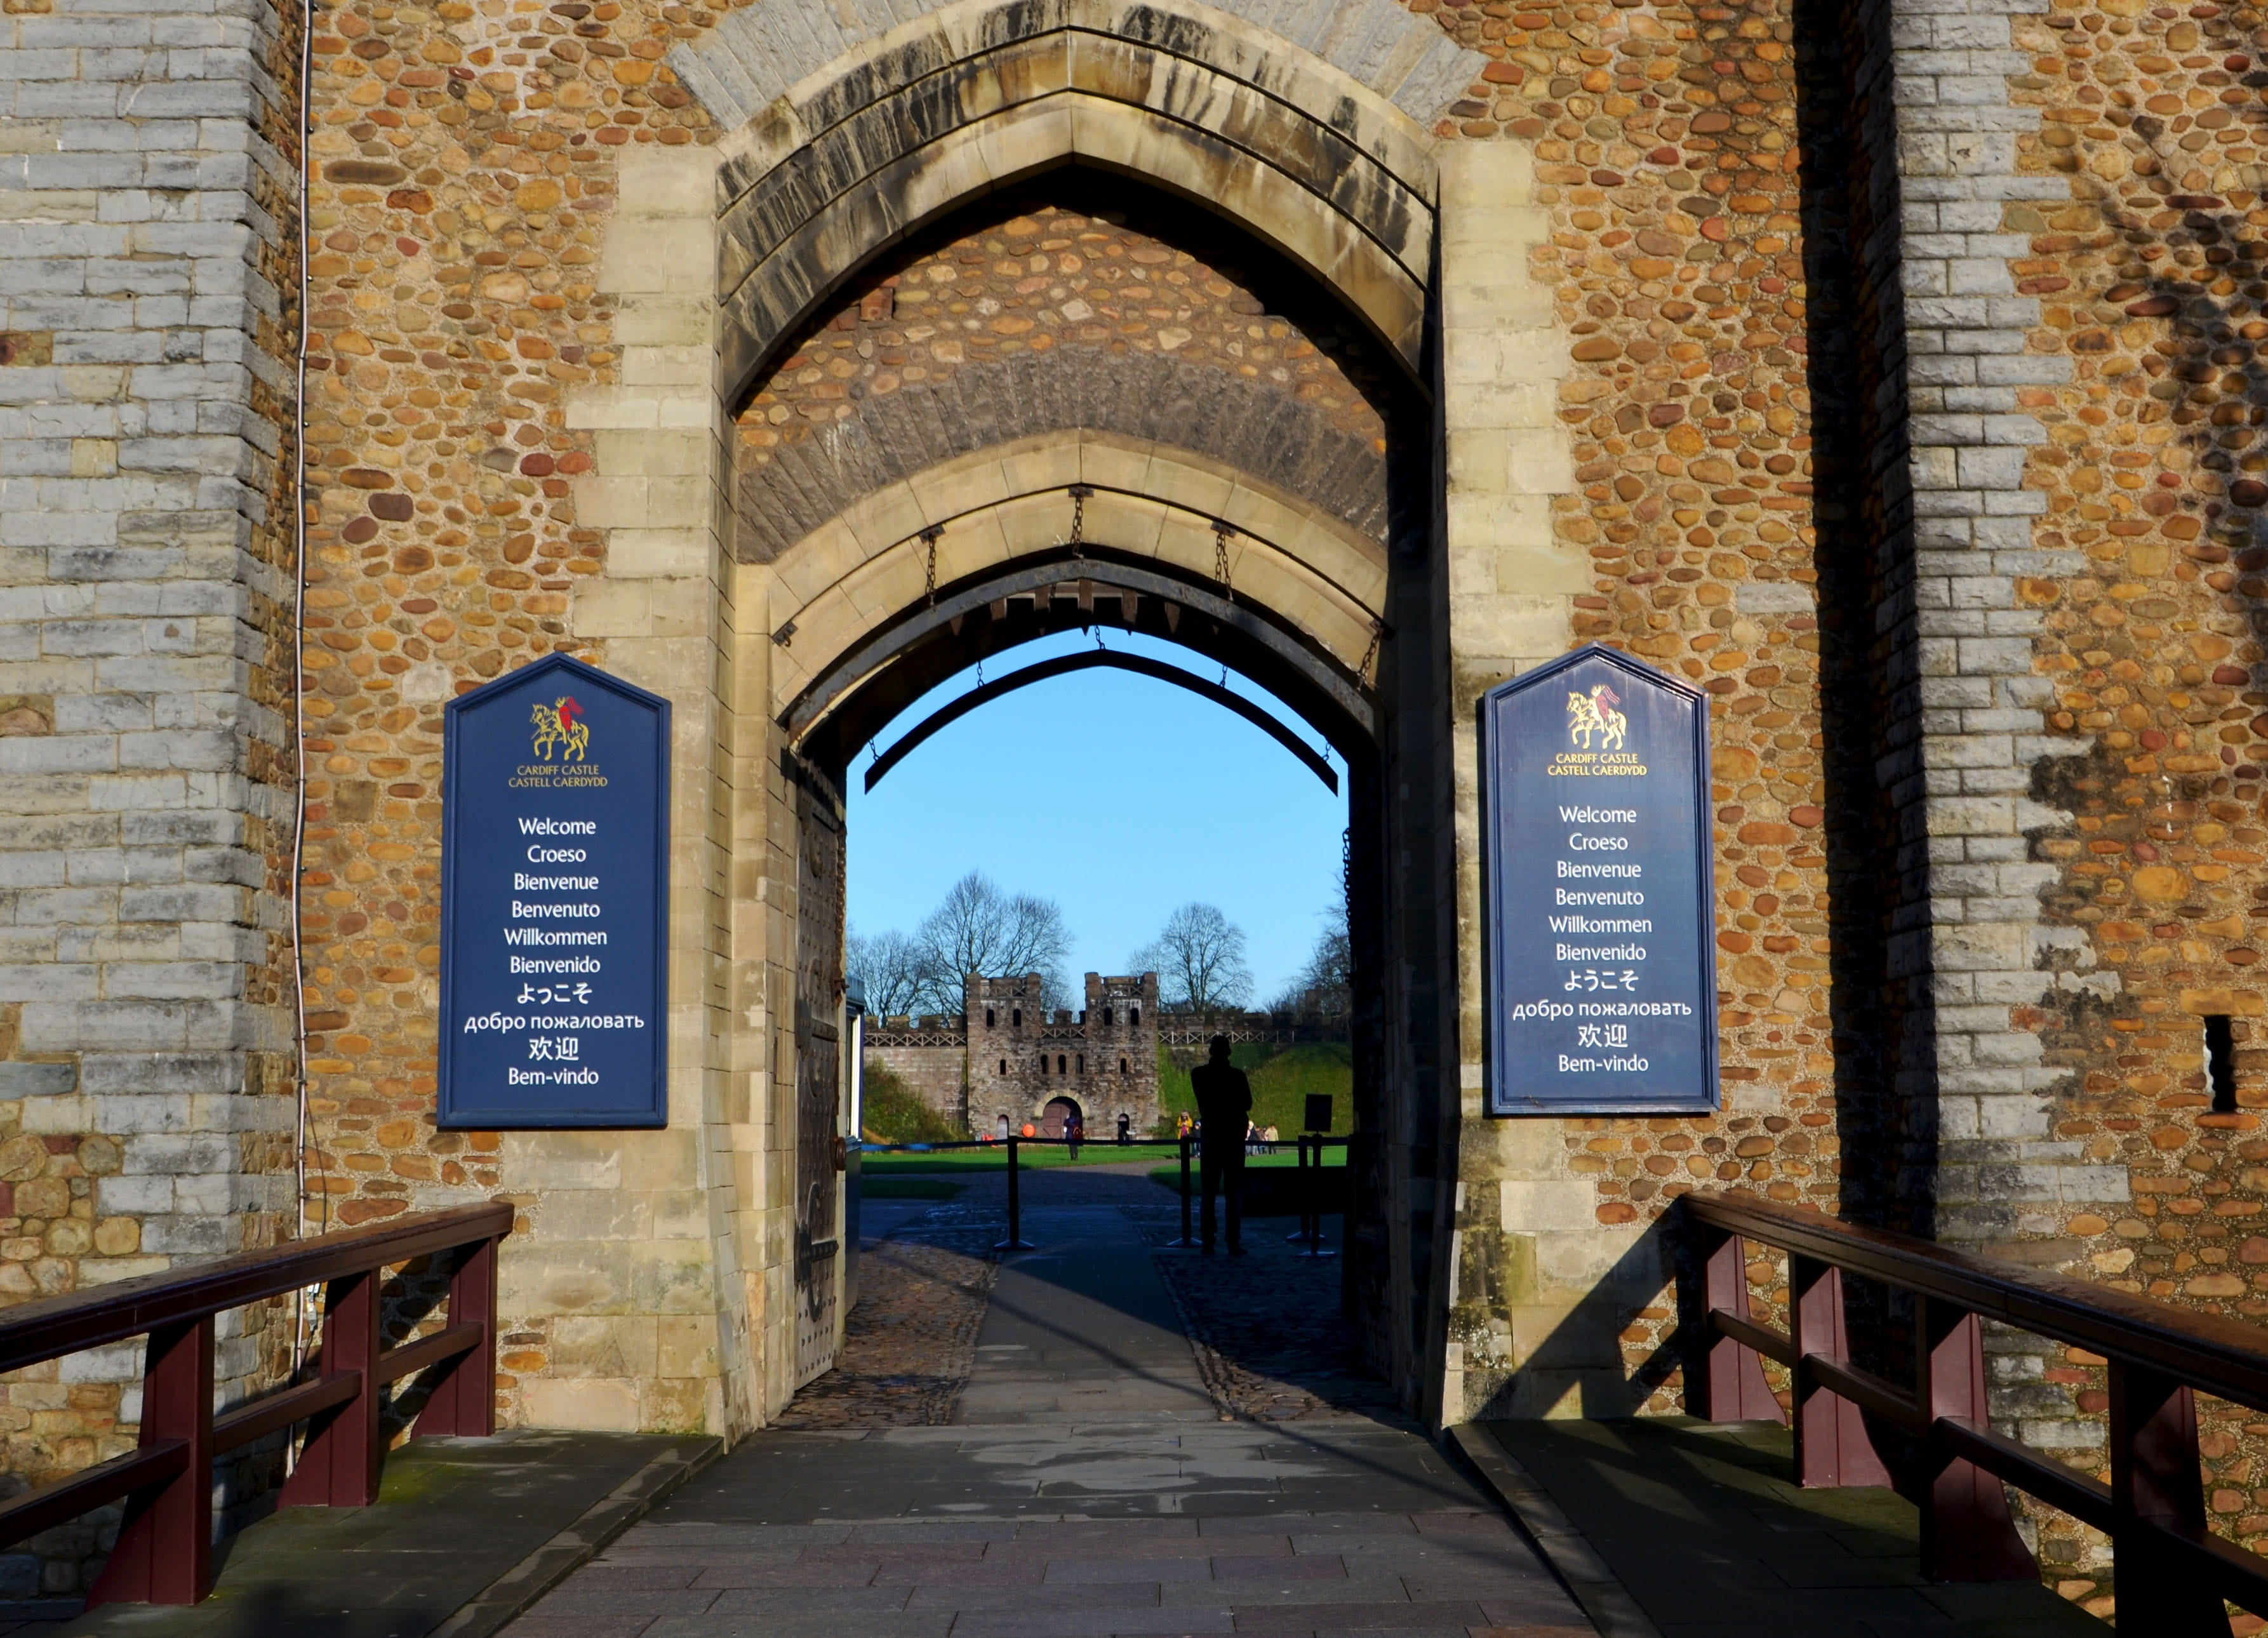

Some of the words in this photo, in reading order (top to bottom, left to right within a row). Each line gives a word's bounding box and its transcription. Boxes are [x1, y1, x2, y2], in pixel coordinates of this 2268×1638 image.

[1556, 753, 1598, 764] CARDIFF
[1599, 753, 1638, 764] CASTLE
[517, 765, 559, 776] CARDIFF
[561, 764, 599, 775] CASTLE
[1547, 764, 1591, 776] CASTELL
[1592, 765, 1647, 776] CAERDYDD
[508, 777, 551, 788] CASTELL
[552, 776, 608, 787] CAERDYDD
[1559, 805, 1637, 823] Welcome
[518, 817, 596, 836] Welcome
[1569, 832, 1629, 851] Croeso
[527, 844, 587, 863] Croeso
[1557, 860, 1642, 878] Bienvenue
[514, 872, 599, 890] Bienvenue
[1556, 888, 1644, 905] Benvenuto
[512, 900, 601, 918] Benvenuto
[1548, 915, 1652, 933] Willkommen
[504, 928, 607, 945] Willkommen
[1556, 943, 1646, 961] Bienvenido
[510, 955, 601, 974] Bienvenido
[1564, 969, 1639, 992] ようこそ
[1512, 999, 1574, 1022] добро
[1578, 1002, 1692, 1016] пожаловать
[464, 1011, 526, 1034] добро
[531, 1015, 644, 1029] пожаловать
[1578, 1023, 1629, 1048] 欢迎
[528, 1035, 580, 1061] 欢迎
[1558, 1053, 1649, 1072] Bem-vindo
[509, 1067, 599, 1085] Bem-vindo
